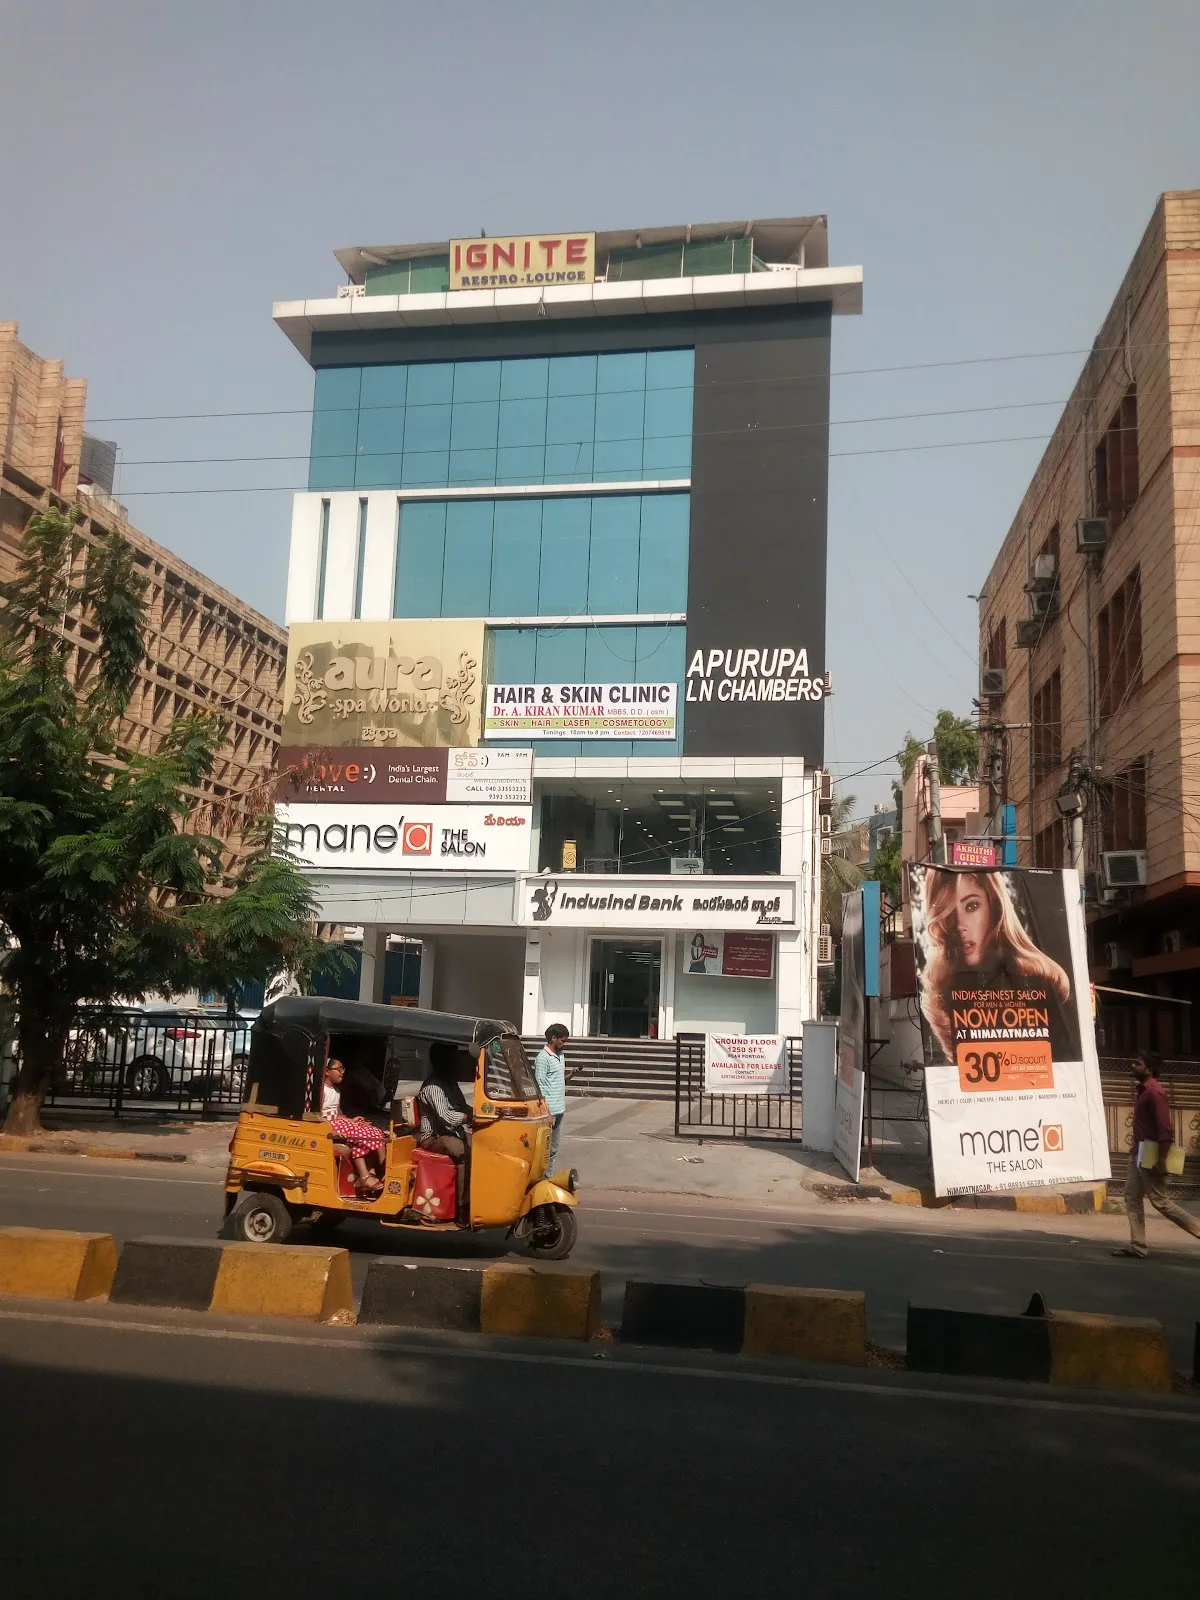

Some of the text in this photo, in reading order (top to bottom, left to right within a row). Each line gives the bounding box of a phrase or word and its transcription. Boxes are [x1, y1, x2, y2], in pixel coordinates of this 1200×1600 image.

[455, 238, 588, 273] IGNITE
[526, 271, 586, 283] LOUNGE
[686, 648, 809, 677] APURUPA
[324, 655, 443, 690] aura
[493, 686, 670, 703] HAIR & SKIN CLINIC
[685, 678, 824, 702] LN CHAMBERS
[333, 693, 429, 719] spa World
[493, 705, 508, 716] Dr.
[511, 705, 521, 716] A.
[525, 705, 560, 716] KIRAN
[563, 705, 605, 716] KUMAR
[388, 764, 439, 774] India's Largest
[441, 828, 468, 842] THE
[440, 841, 486, 855] SALON
[956, 845, 993, 856] AKRUTHI
[960, 853, 988, 864] GIRL'S
[560, 892, 684, 911] IndusInd Bank
[952, 989, 1047, 1000] INDIA'S FINEST SALON
[953, 1008, 1049, 1028] NOW OPEN
[956, 1028, 1050, 1039] AT HIMAYATNAGAR
[1010, 1054, 1047, 1065] Discount
[965, 1051, 1010, 1083] 30%
[987, 1158, 1043, 1173] THE SALON
